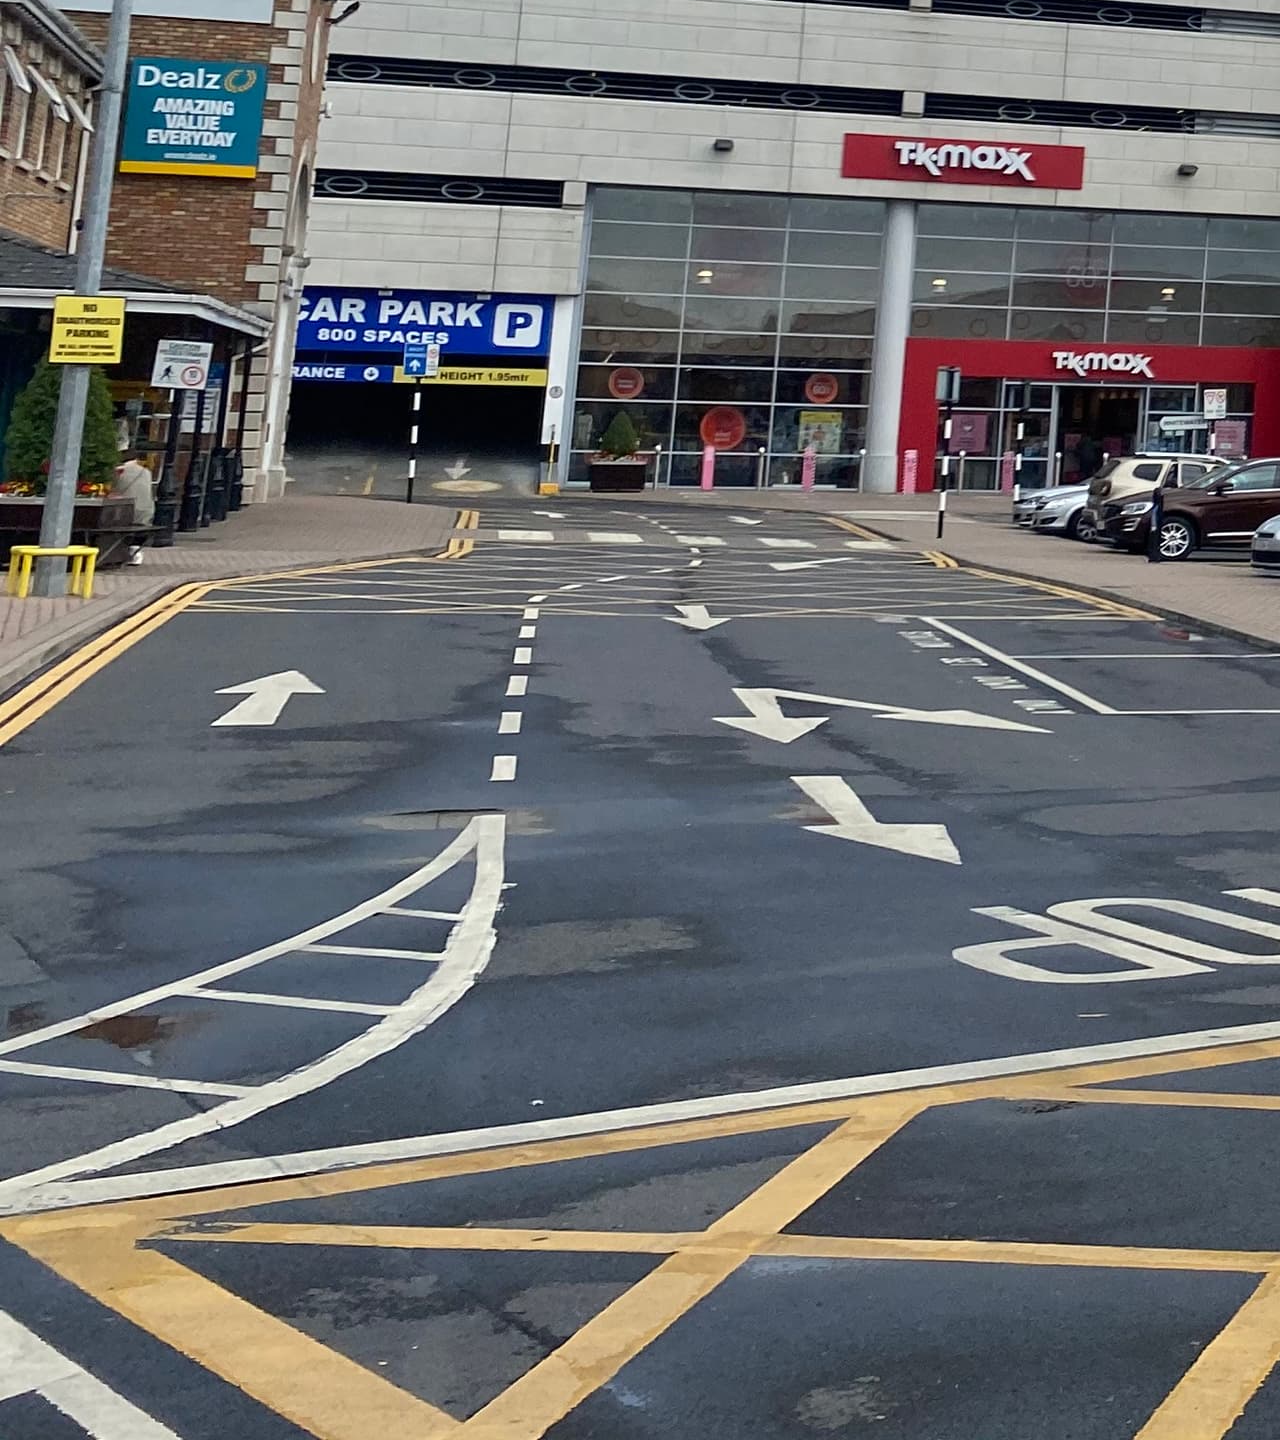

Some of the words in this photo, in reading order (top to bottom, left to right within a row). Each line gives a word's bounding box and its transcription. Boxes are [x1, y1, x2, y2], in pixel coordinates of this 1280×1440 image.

[137, 65, 222, 90] Dealz
[152, 97, 235, 116] AMAZING
[165, 114, 222, 131] VALUE
[146, 129, 237, 148] EVERYDAY
[83, 303, 97, 312] NO
[378, 300, 485, 328] PARK
[65, 329, 109, 338] PARKING
[317, 328, 357, 342] 800
[363, 329, 450, 345] SPACES
[290, 366, 346, 379] RANCE
[440, 371, 484, 382] HEIGHT
[487, 372, 530, 382] 1.95mtr
